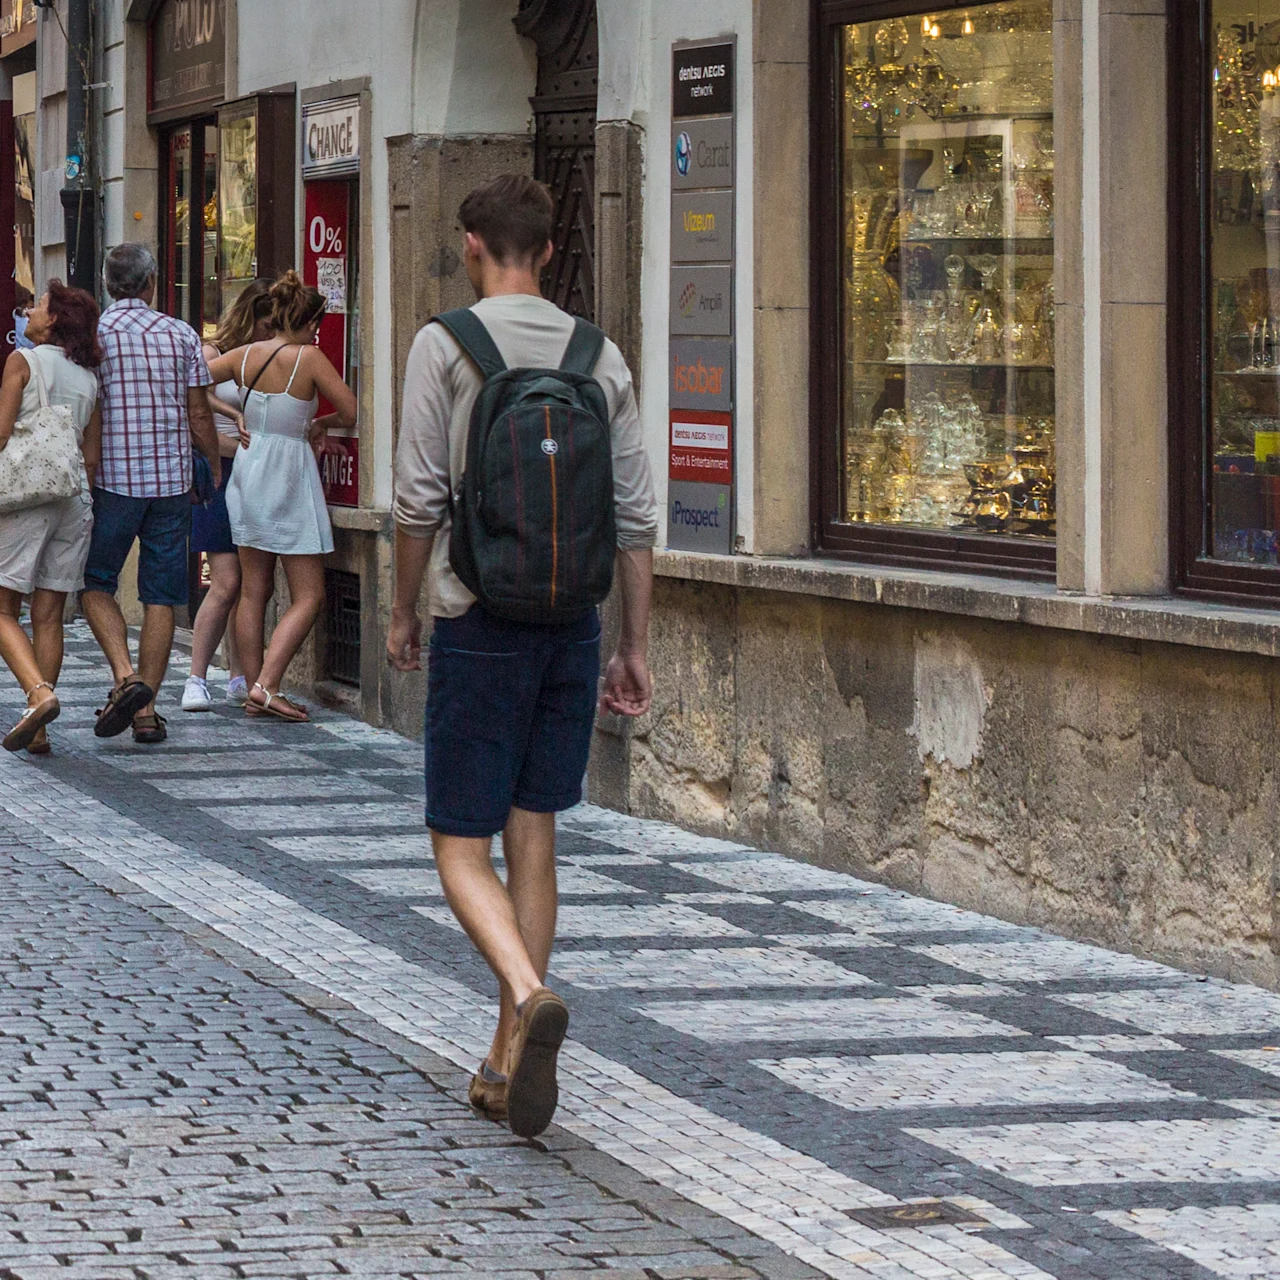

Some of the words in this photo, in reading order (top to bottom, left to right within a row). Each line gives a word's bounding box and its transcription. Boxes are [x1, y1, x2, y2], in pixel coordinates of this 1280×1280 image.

[678, 65, 702, 82] dentsu
[690, 83, 714, 98] network
[308, 116, 354, 162] CHANGE
[696, 140, 730, 169] Carat
[309, 215, 343, 253] 0%
[683, 211, 716, 232] Vizeum
[673, 354, 725, 396] isobar
[321, 453, 354, 487] ANGE
[671, 453, 686, 468] Sport
[691, 455, 729, 470] Entertainment
[671, 500, 720, 533] iProspect
